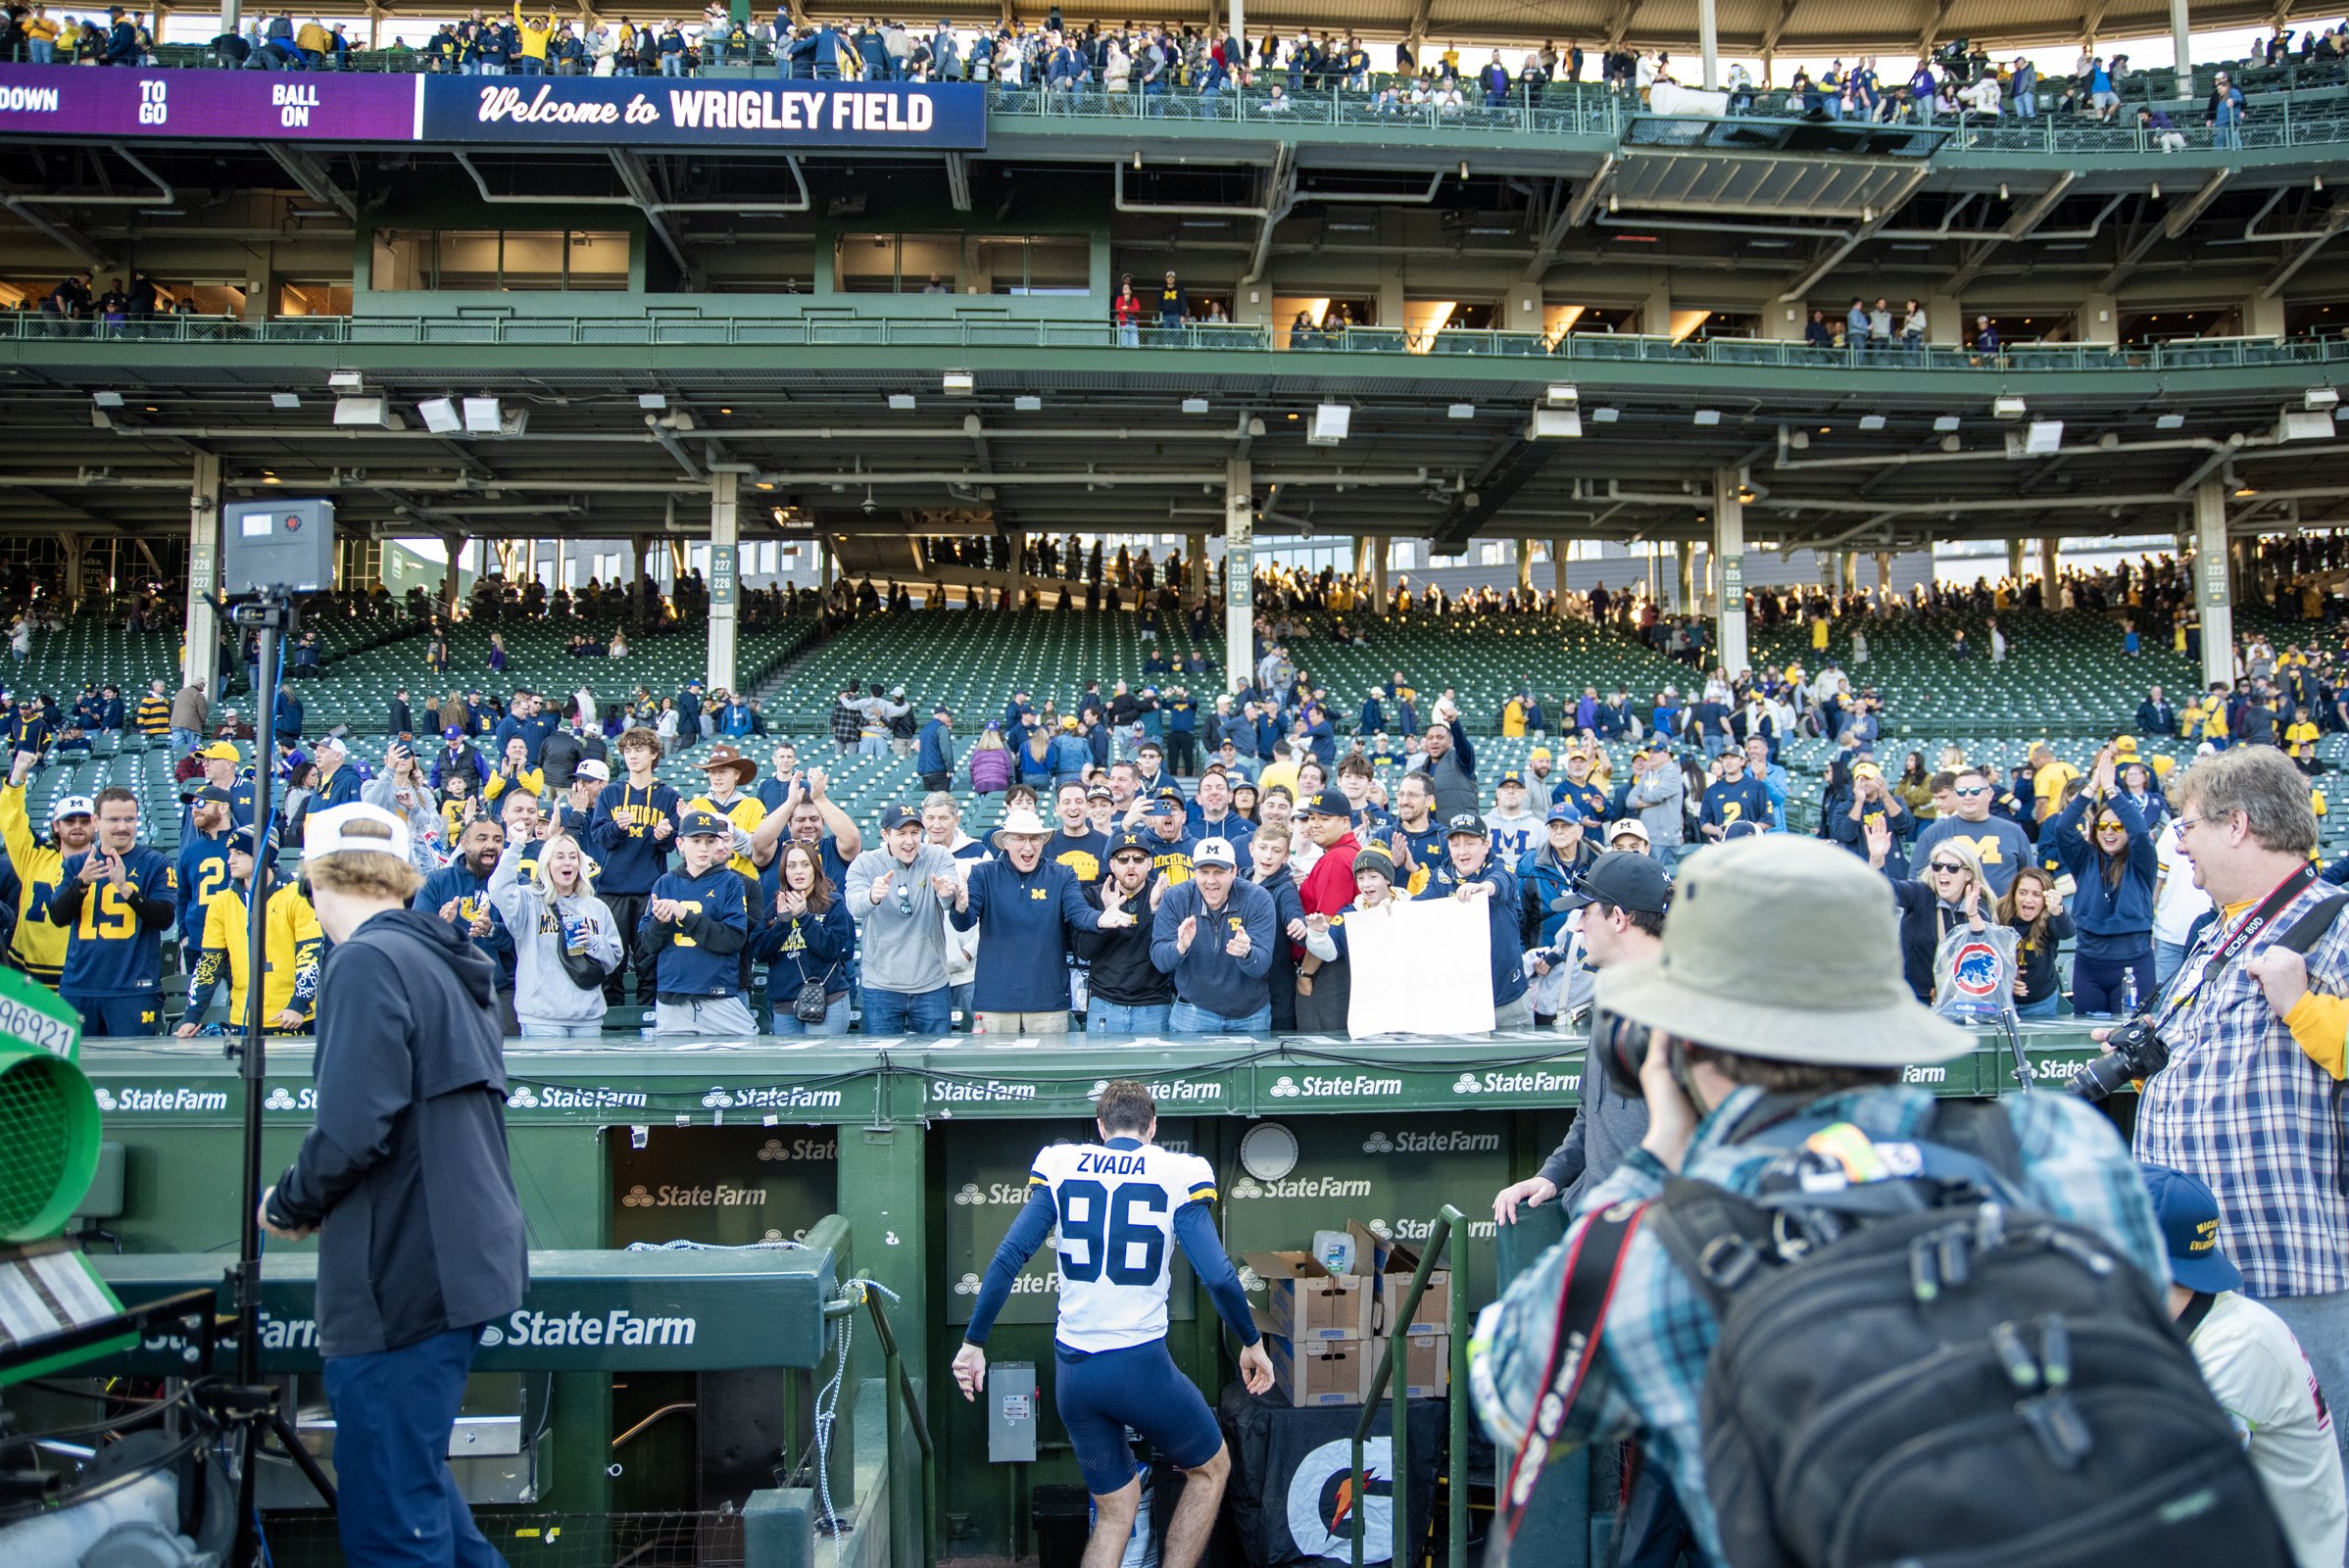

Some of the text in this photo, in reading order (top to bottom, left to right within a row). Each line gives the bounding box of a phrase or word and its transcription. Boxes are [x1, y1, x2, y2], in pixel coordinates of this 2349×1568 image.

[139, 80, 167, 102] TO
[272, 84, 319, 106] BALL
[139, 102, 167, 124] GO
[478, 84, 933, 131] Welcome to WRIGLEY FIELD
[281, 105, 309, 126] ON
[193, 559, 211, 570] 228
[714, 560, 731, 571] 227
[1231, 564, 1248, 574] 226
[2207, 564, 2225, 576] 223
[1725, 569, 1741, 581] 225
[193, 576, 210, 588] 227
[713, 577, 731, 589] 226
[1231, 580, 1248, 592] 225
[2208, 581, 2226, 593] 222
[1725, 586, 1742, 598] 223
[1161, 787, 1174, 796] M
[1310, 795, 1323, 806] M
[900, 806, 915, 816] M
[697, 815, 711, 826] M
[628, 826, 644, 838] M
[1124, 835, 1137, 845] M
[1490, 828, 1531, 855] M
[1205, 844, 1220, 855] M
[1427, 844, 1440, 855] M
[1953, 834, 2003, 864] M
[1152, 852, 1195, 869] MICHIGA
[198, 857, 225, 906] 2
[1031, 888, 1047, 900] M
[2225, 916, 2265, 957] EOS 80D
[141, 1010, 155, 1023] M
[1076, 1152, 1146, 1176] ZVADA
[1057, 1179, 1169, 1287] 96
